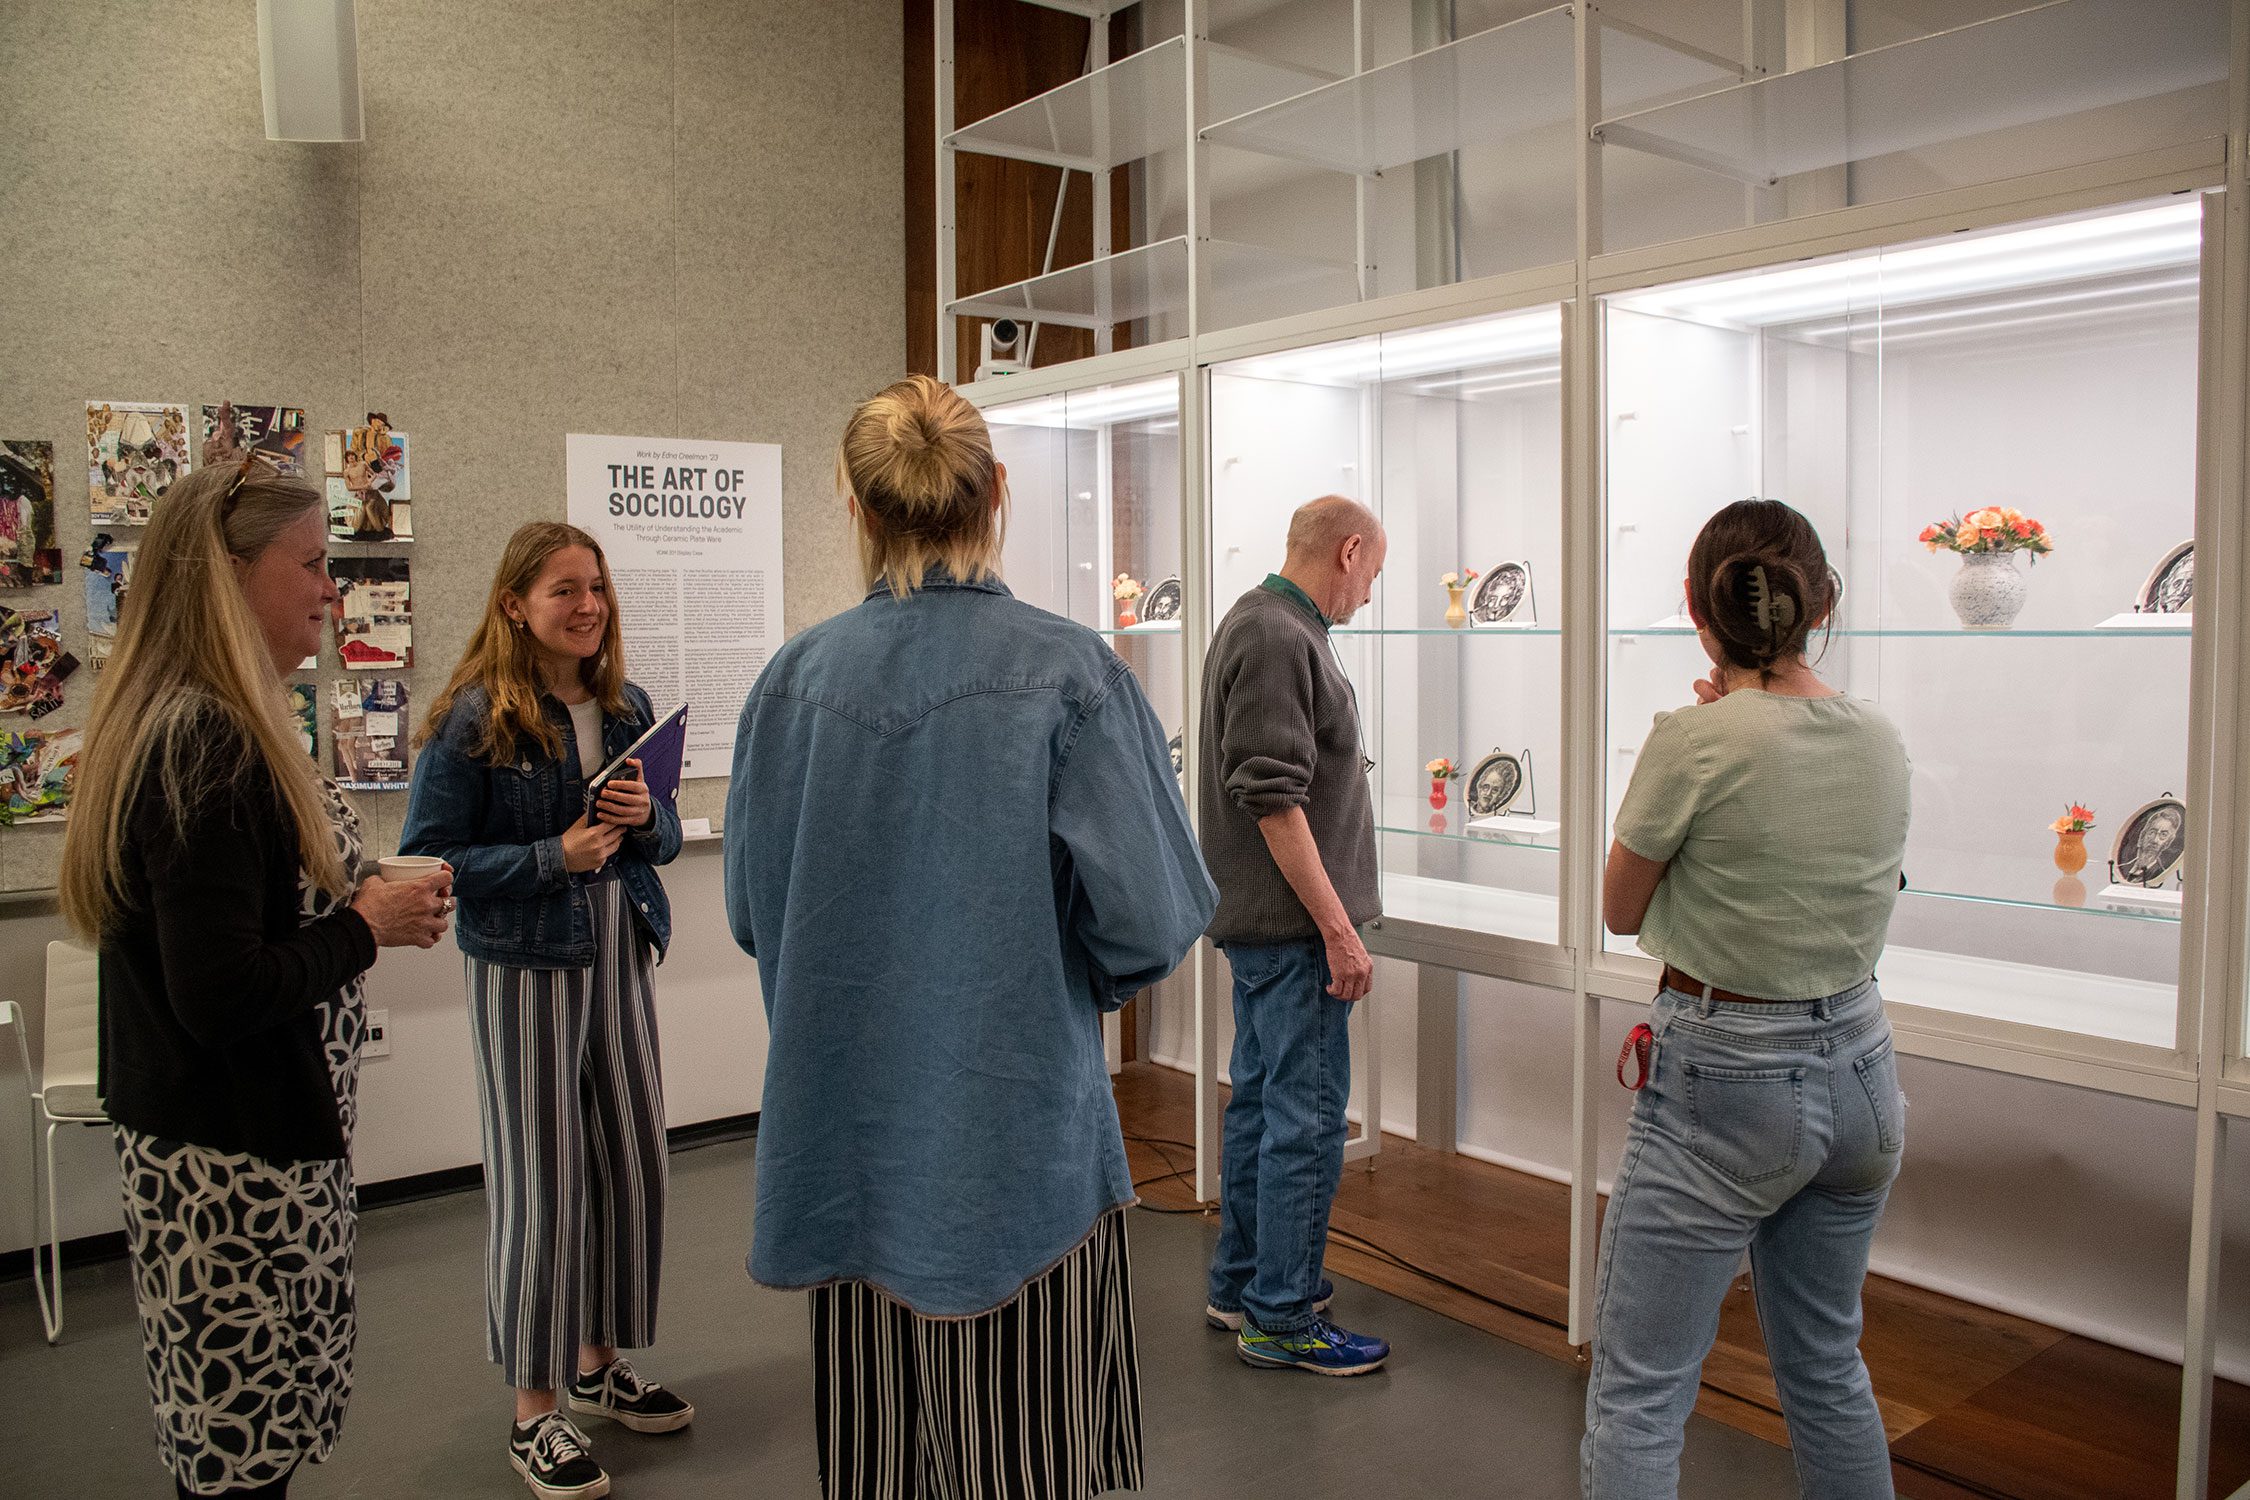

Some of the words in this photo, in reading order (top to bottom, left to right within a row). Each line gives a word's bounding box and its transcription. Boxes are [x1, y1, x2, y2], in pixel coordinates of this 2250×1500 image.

[653, 451, 660, 460] by
[608, 465, 654, 489] THE
[662, 467, 707, 491] ART
[715, 469, 744, 492] OF
[609, 492, 746, 519] SOCIOLOGY
[626, 524, 645, 532] Utility
[655, 524, 700, 534] Understanding
[713, 525, 743, 533] Academic
[636, 535, 661, 544] Through
[30, 703, 49, 718] SAY
[338, 782, 381, 790] MAXIMUM
